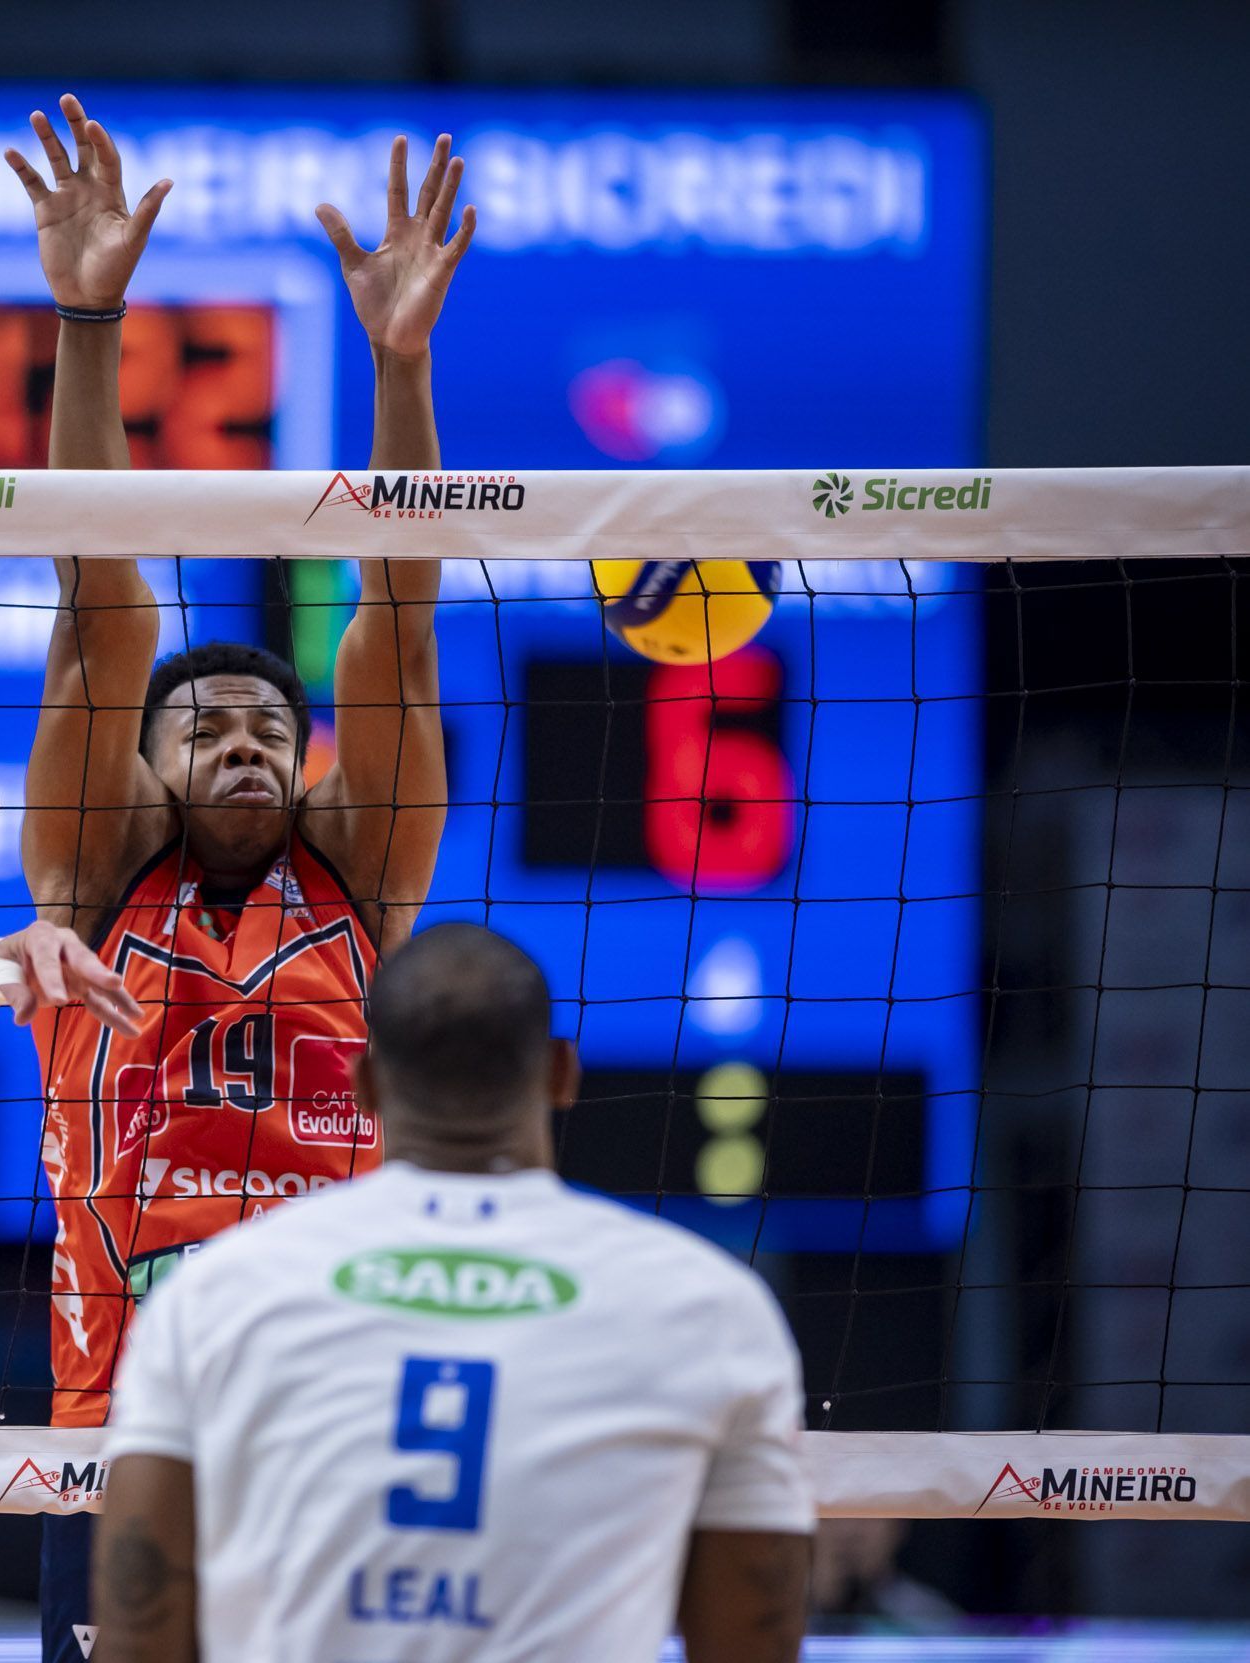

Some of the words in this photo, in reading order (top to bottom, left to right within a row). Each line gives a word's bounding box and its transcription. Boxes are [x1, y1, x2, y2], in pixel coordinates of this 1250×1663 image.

[370, 475, 526, 511] MINEIRO
[412, 475, 517, 484] CAMPEONATO
[861, 477, 992, 510] Sicredi
[373, 510, 392, 519] DE
[182, 1012, 276, 1113] 19
[298, 1110, 374, 1137] Evolutto
[352, 1257, 560, 1309] SADA
[386, 1355, 496, 1533] 9
[1040, 1467, 1197, 1502] MINEIRO
[1082, 1466, 1187, 1476] CAMPEONATO
[1043, 1502, 1062, 1511] DE
[348, 1564, 495, 1630] LEAL
